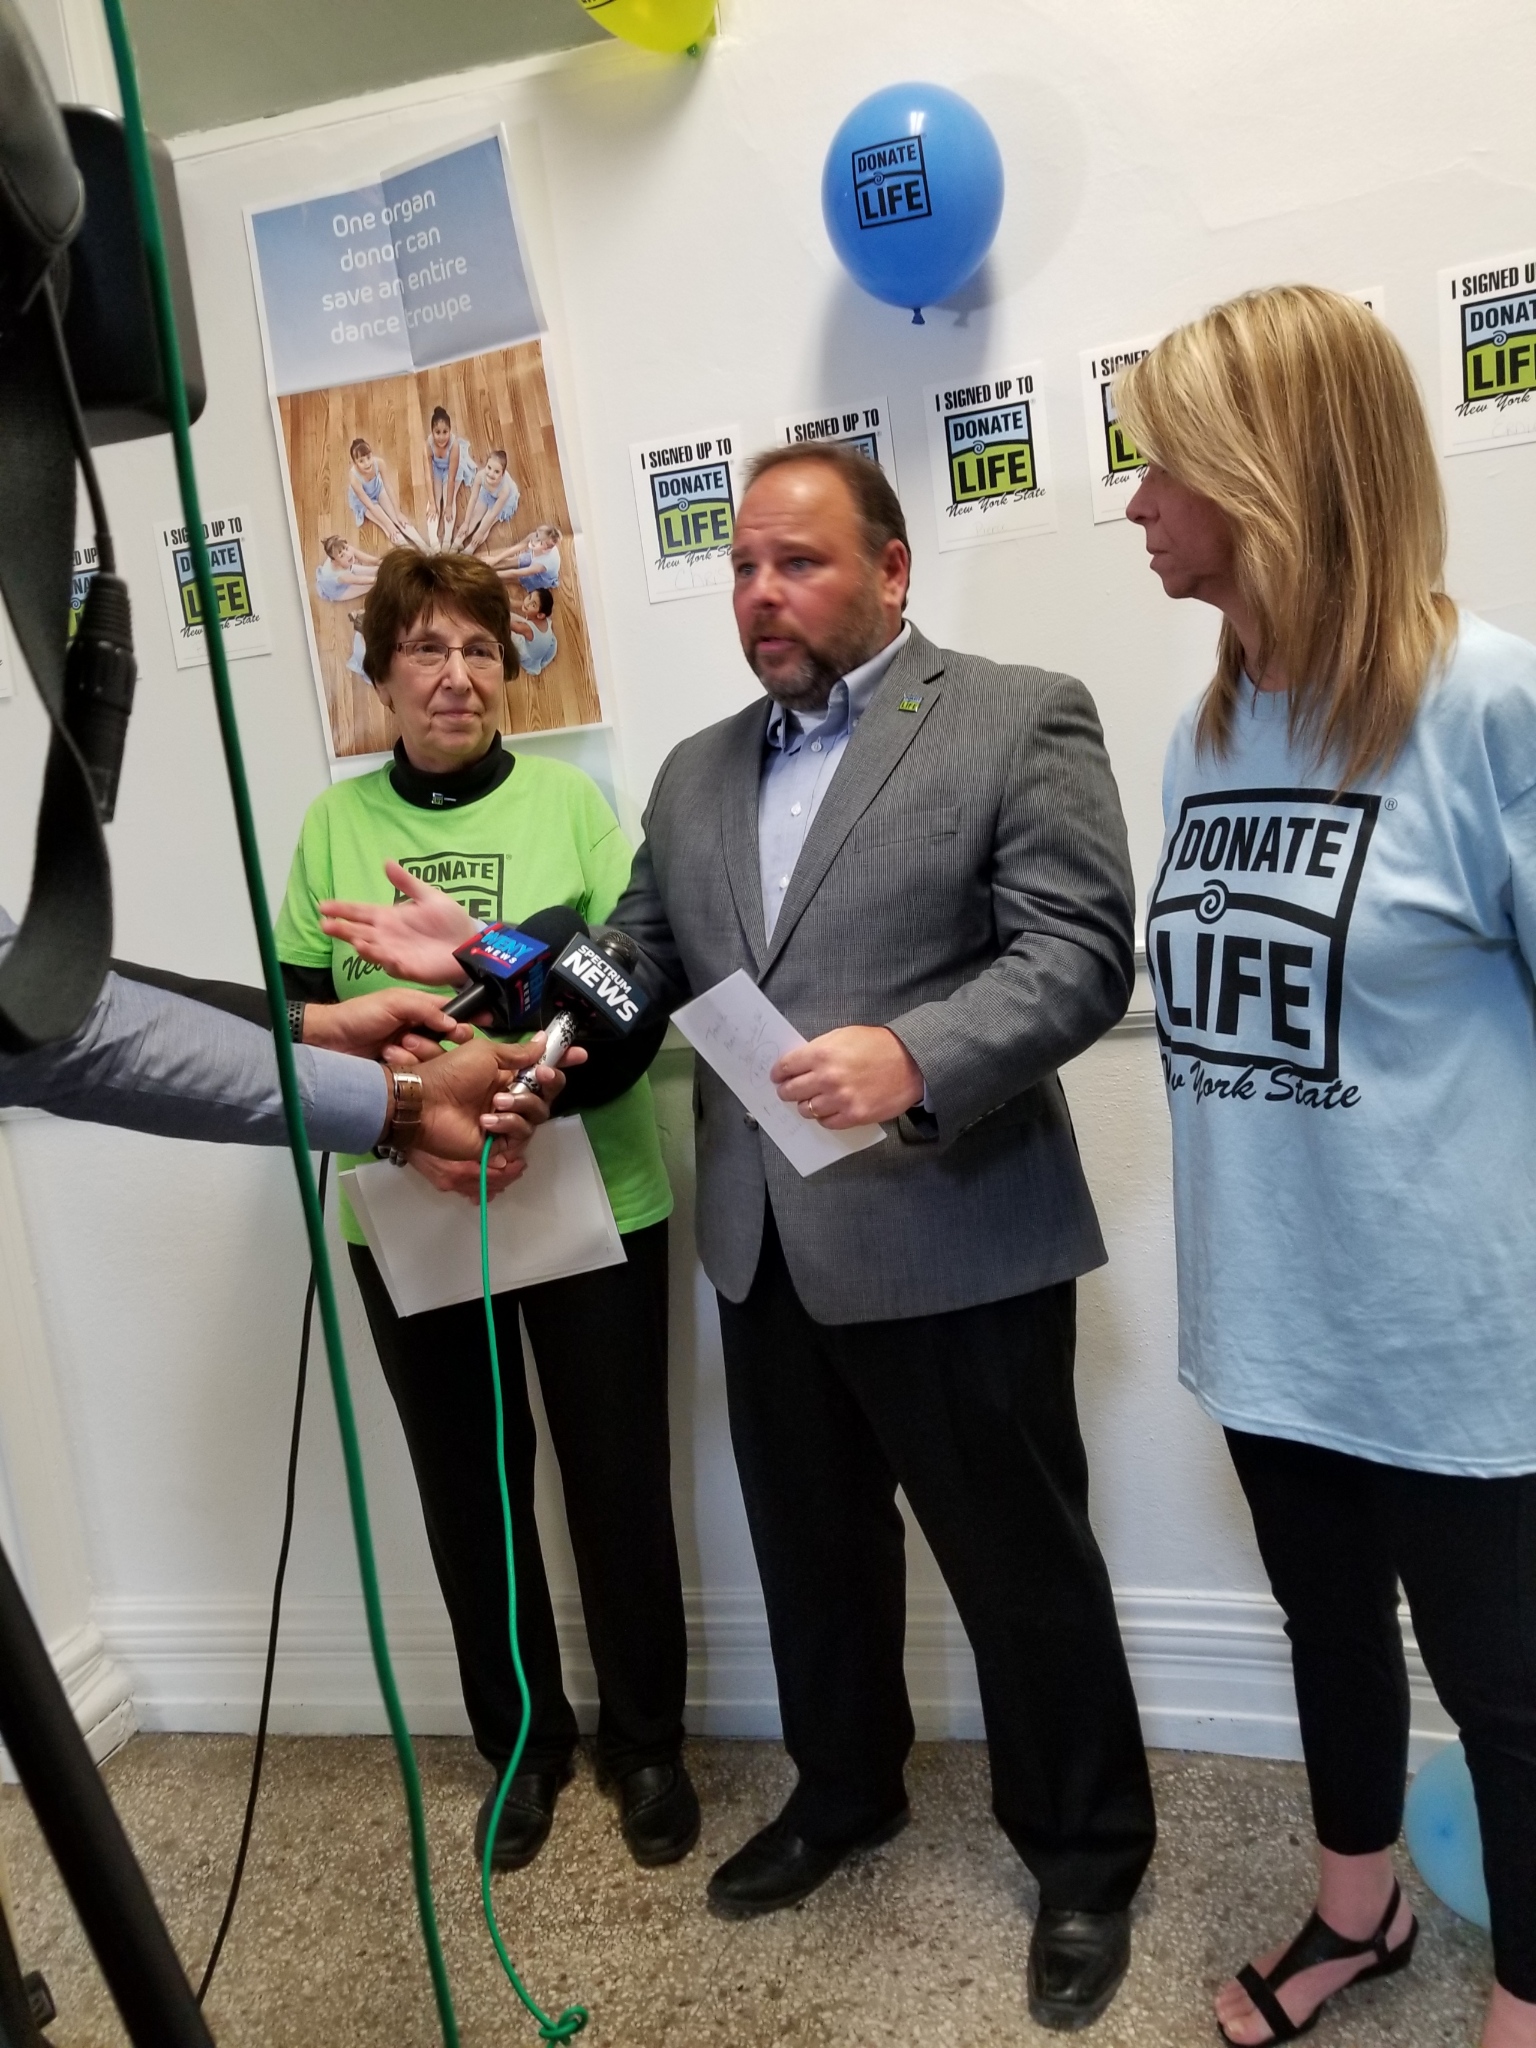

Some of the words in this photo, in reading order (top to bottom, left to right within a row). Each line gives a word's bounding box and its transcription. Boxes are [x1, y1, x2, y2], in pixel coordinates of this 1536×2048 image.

[858, 144, 917, 173] DONATE
[333, 212, 375, 237] One
[381, 190, 436, 224] organ
[862, 180, 923, 219] LIFE
[340, 241, 402, 272] donor
[407, 227, 440, 253] can
[322, 285, 372, 311] save
[379, 278, 404, 299] an
[408, 256, 467, 290] entire
[1452, 280, 1456, 299] I
[1462, 267, 1519, 297] SIGNED
[1525, 262, 1536, 283] U
[331, 316, 400, 344] dance
[404, 294, 472, 328] troupe
[1471, 299, 1536, 332] DONAT
[1092, 361, 1096, 378] I
[1473, 343, 1536, 391] LIF
[935, 394, 941, 412] I
[944, 384, 991, 410] SIGNED
[995, 380, 1012, 399] UP
[1016, 375, 1034, 396] TO
[1455, 401, 1488, 417] New
[1495, 389, 1531, 411] York
[785, 427, 791, 444] I
[794, 417, 839, 441] SIGNED
[843, 413, 859, 432] UP
[862, 408, 879, 427] TO
[953, 410, 1023, 442] DONATE
[641, 453, 646, 470] I
[649, 444, 693, 468] SIGNED
[696, 442, 712, 459] UP
[716, 437, 732, 455] TO
[958, 449, 1027, 494] LIFE
[658, 470, 724, 498] DONATE
[1101, 472, 1130, 487] New
[945, 500, 973, 518] New
[978, 491, 1008, 512] York
[1013, 486, 1046, 503] State
[163, 531, 168, 547] I
[211, 520, 225, 537] UP
[228, 517, 242, 534] TO
[664, 508, 730, 549] LIFE
[180, 547, 237, 572] DATE
[654, 554, 680, 571] New
[684, 546, 712, 565] York
[187, 581, 244, 618] LFE
[235, 614, 260, 626] State
[1175, 816, 1349, 879] DONATE
[408, 860, 493, 883] DONATE
[481, 930, 533, 957] WENY
[485, 945, 517, 964] NEWS
[562, 951, 639, 1022] NEWS
[577, 944, 632, 994] SPECTRUM
[1156, 930, 1313, 1050] LIFE
[1190, 1060, 1257, 1105] York
[1265, 1065, 1362, 1110] State
